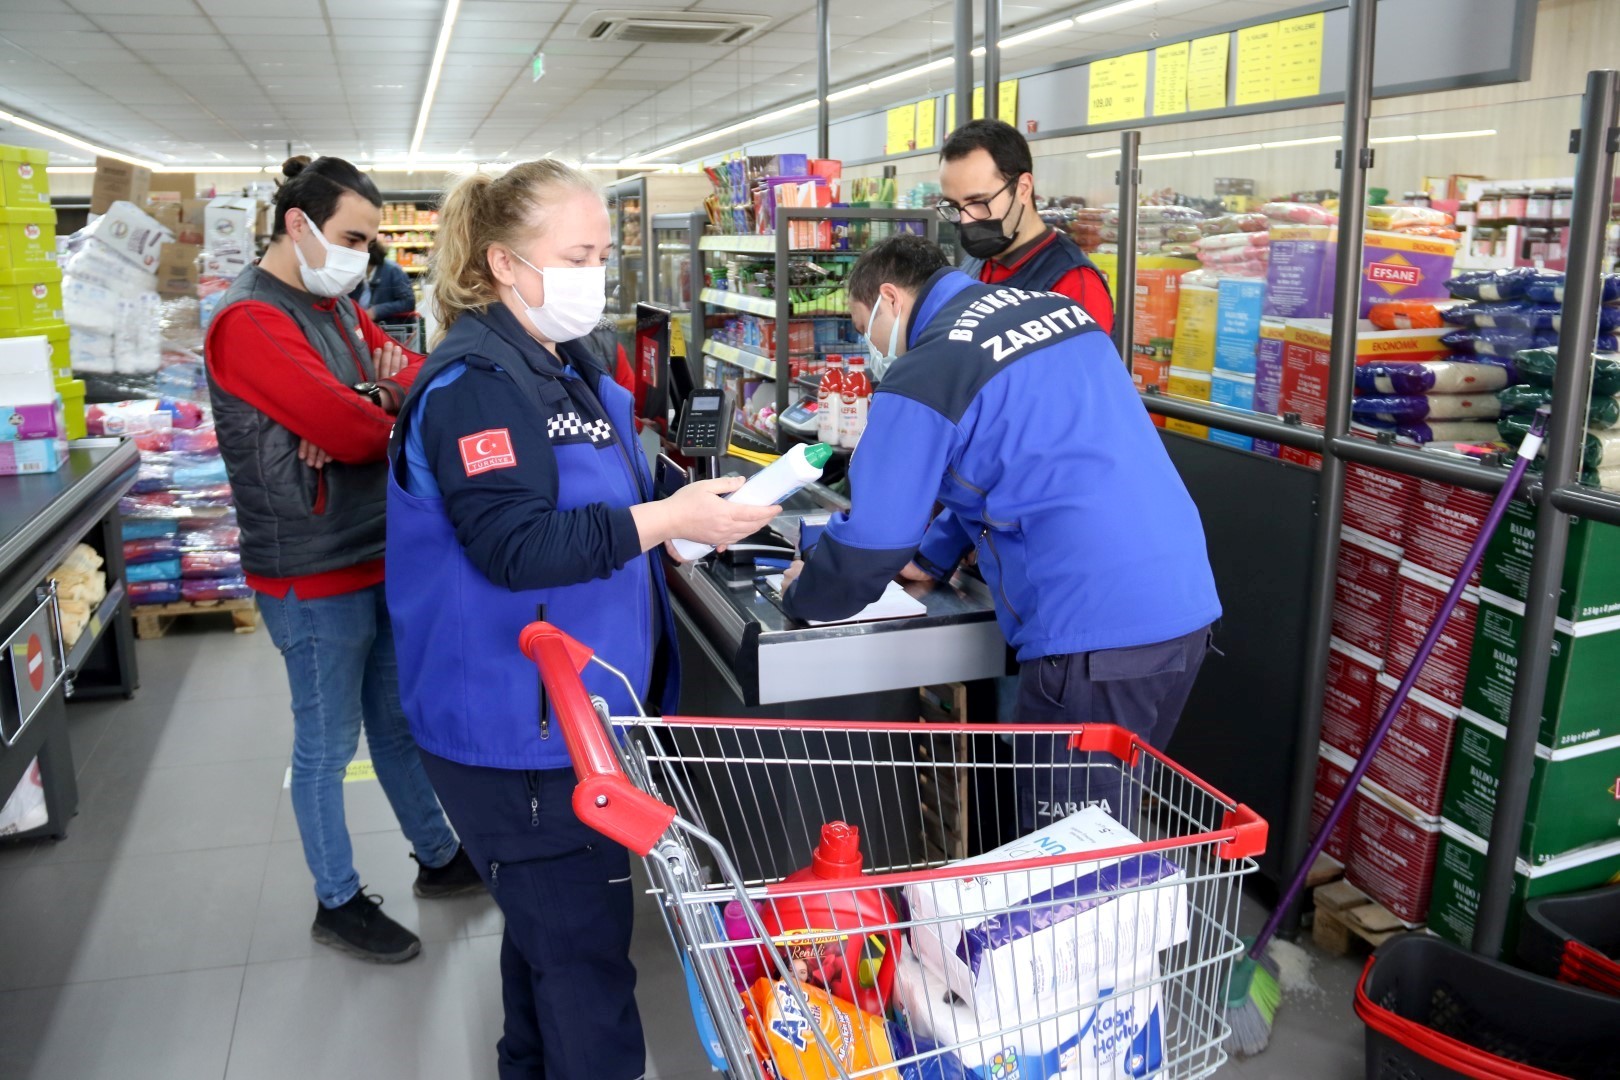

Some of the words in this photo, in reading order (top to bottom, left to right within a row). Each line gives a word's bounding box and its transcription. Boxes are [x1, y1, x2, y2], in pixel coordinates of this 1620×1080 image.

[1373, 267, 1416, 281] EFSANE
[949, 287, 1070, 342] BÜYÜKŞE
[980, 305, 1096, 362] ZABITA
[1372, 340, 1419, 351] EKONOMİK
[1510, 522, 1535, 540] BALDO
[1493, 648, 1517, 668] BALDO
[1470, 764, 1493, 785] BALDO
[1453, 879, 1476, 899] BALDO
[1093, 1024, 1138, 1058] Havlu
